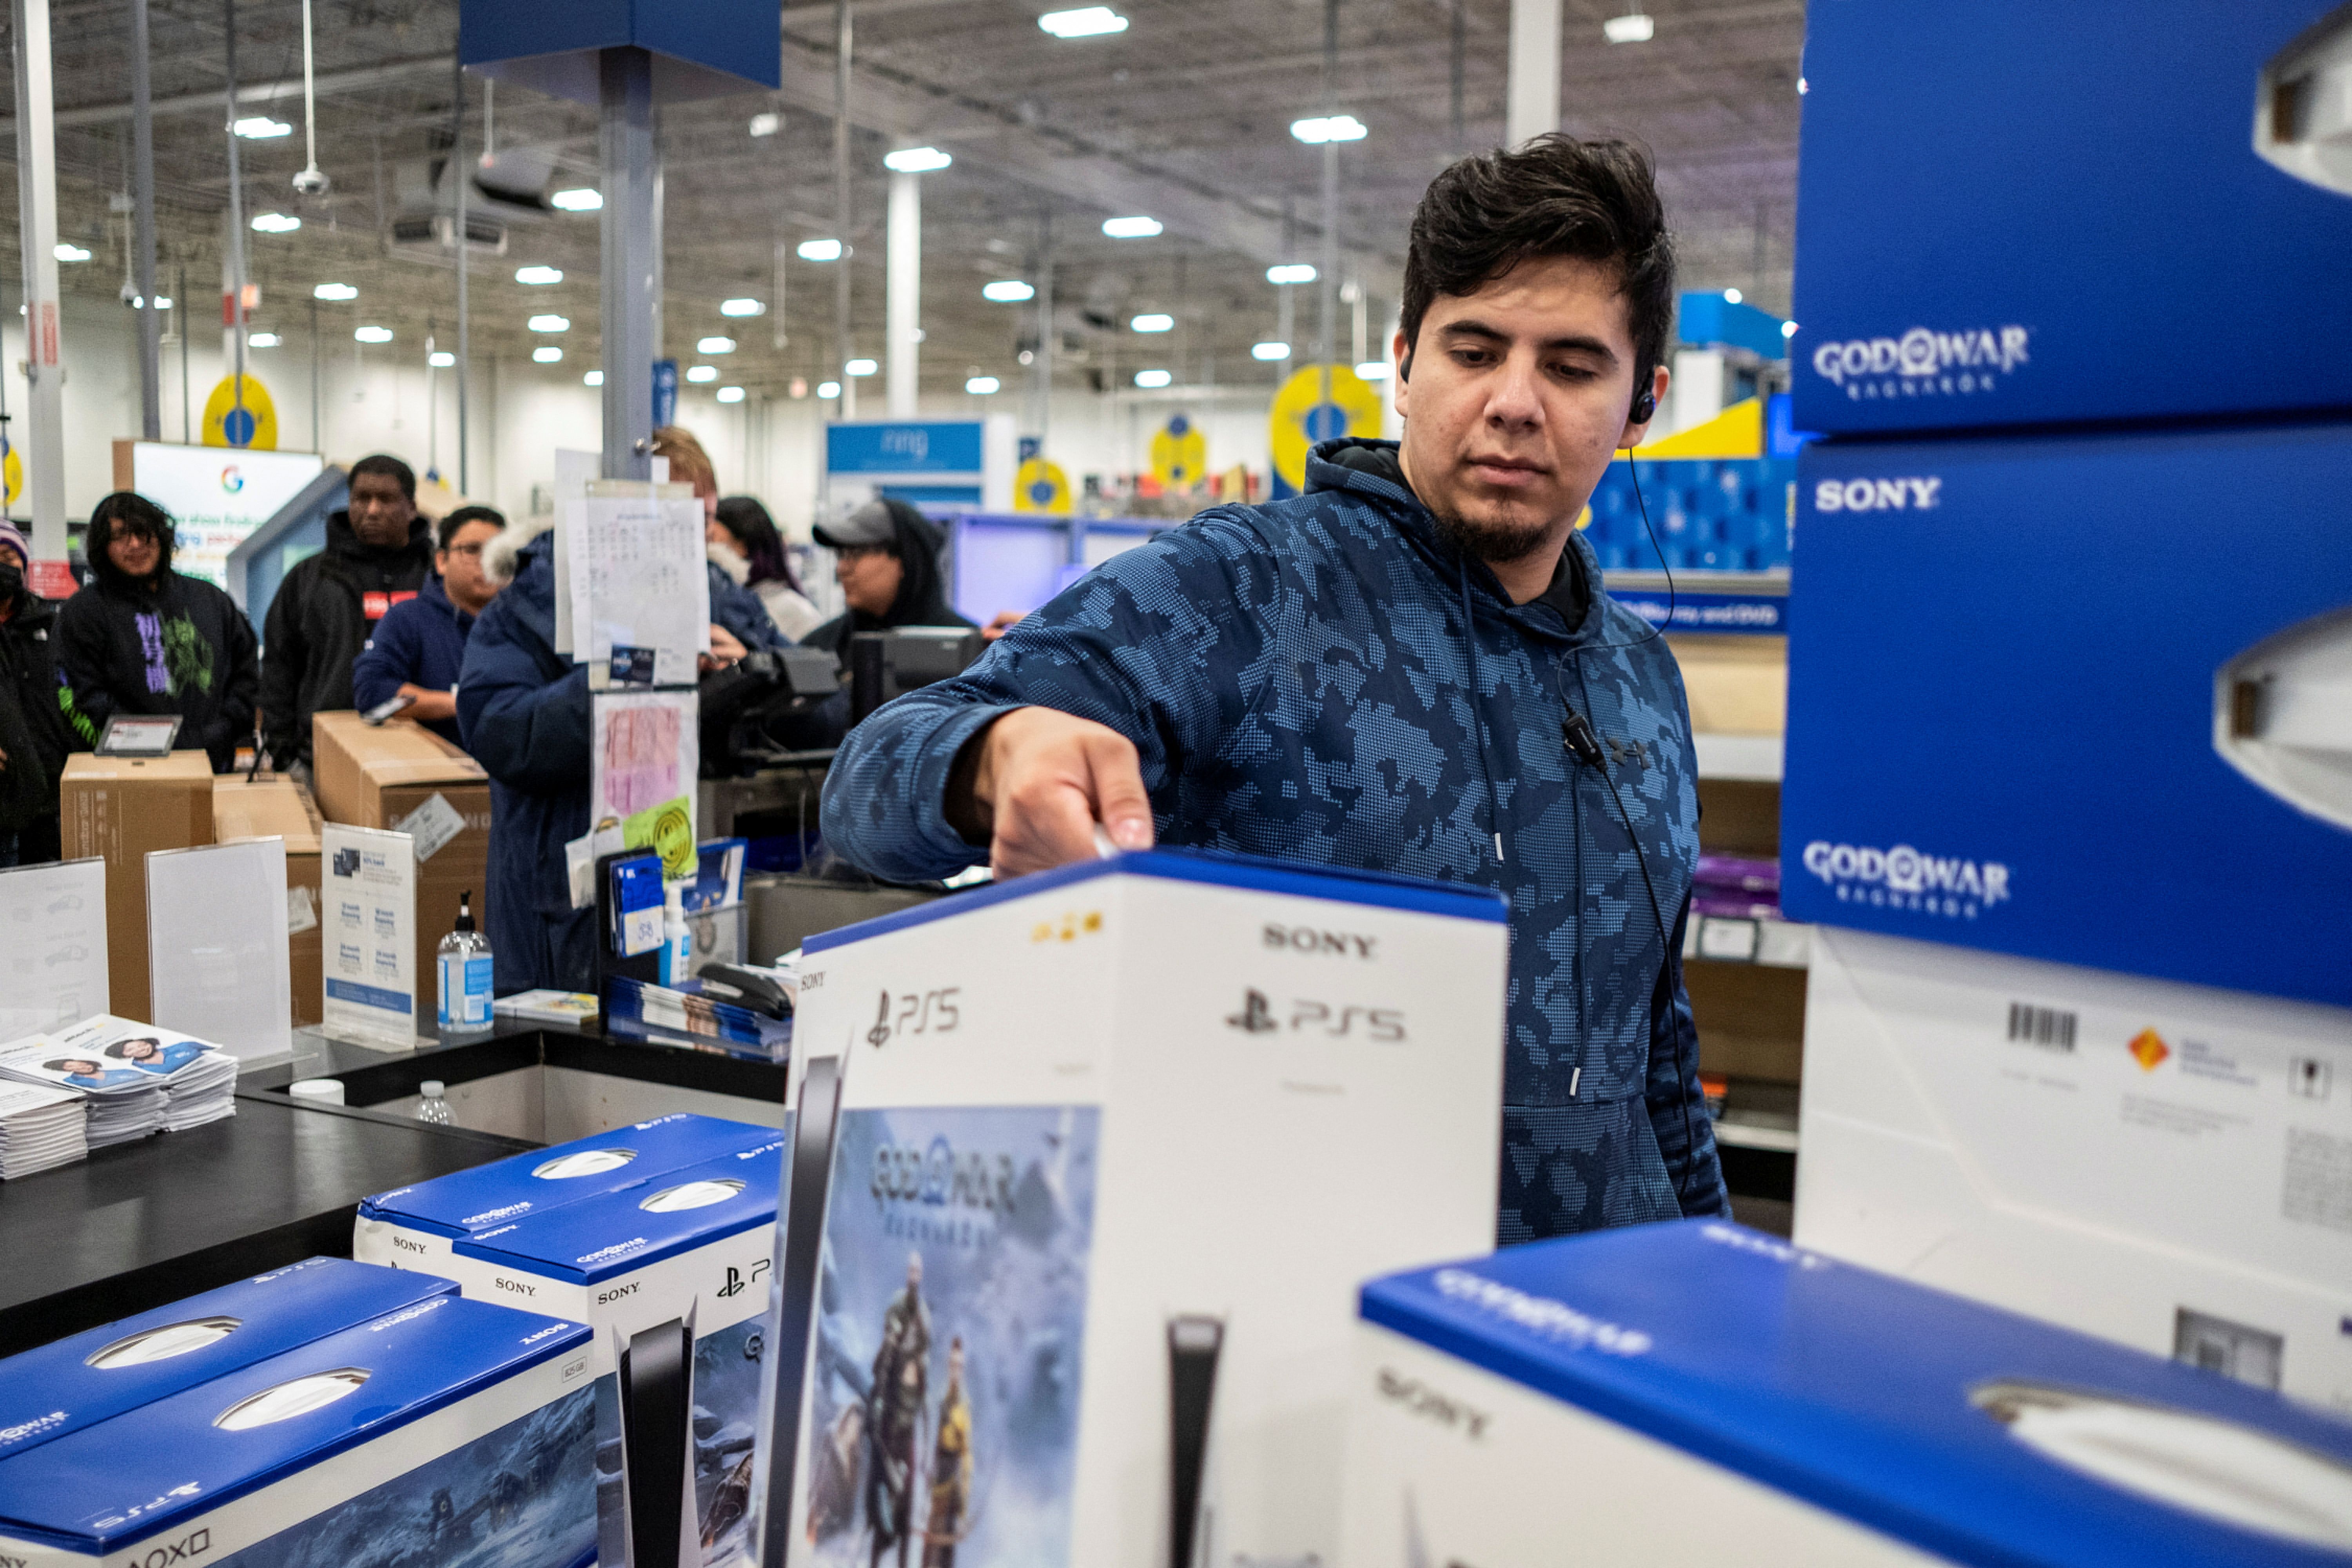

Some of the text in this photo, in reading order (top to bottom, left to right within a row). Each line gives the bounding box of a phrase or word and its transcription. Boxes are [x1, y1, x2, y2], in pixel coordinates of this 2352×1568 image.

[1815, 478, 1940, 512] SONY
[1263, 924, 1377, 960] SONY
[801, 971, 826, 991] SONY
[898, 987, 960, 1034] PS5
[1290, 999, 1407, 1042] PS5
[393, 1236, 426, 1254] SONY
[495, 1278, 536, 1296] SONY
[598, 1282, 640, 1305] SONY
[519, 1323, 569, 1345] SONY
[1378, 1365, 1494, 1442] SONY
